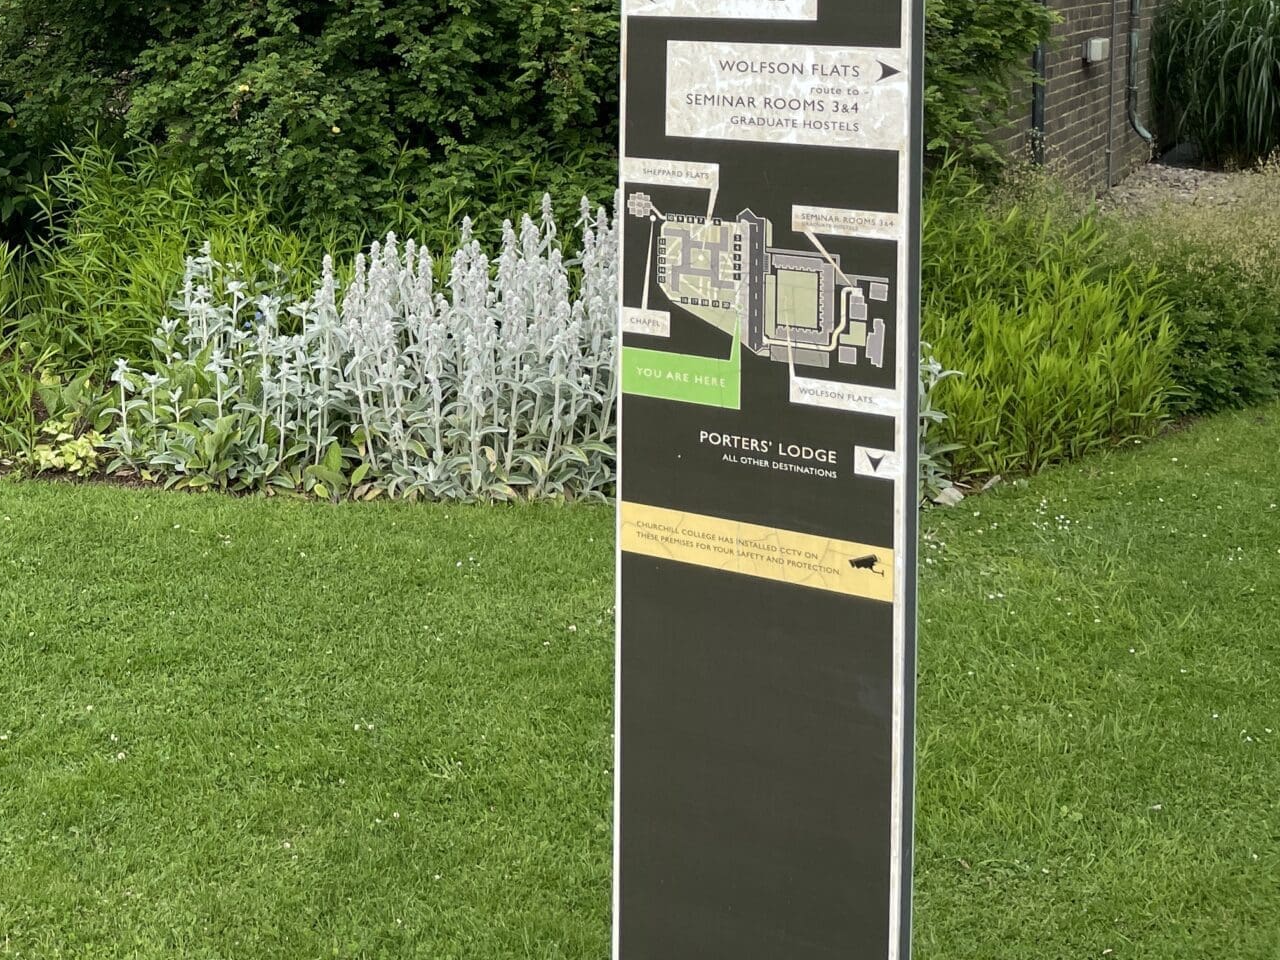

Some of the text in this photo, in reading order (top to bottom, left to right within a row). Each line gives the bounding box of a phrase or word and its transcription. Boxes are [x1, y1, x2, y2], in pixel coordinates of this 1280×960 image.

[719, 59, 860, 78] WOLFSON FLATS
[810, 86, 842, 95] route
[847, 87, 859, 96] to
[686, 93, 859, 114] SEMINAR ROOMS 3&4
[730, 115, 859, 132] GRADUATE HOSTELS
[642, 168, 710, 180] SHEPPARD FLATS
[801, 213, 841, 223] SEMINAR
[843, 216, 876, 226] ROOMS
[630, 317, 660, 328] CHAPEL
[636, 367, 726, 388] YOU ARE HERE
[798, 386, 873, 404] WOLFSON FLATS
[699, 430, 837, 464] PORTERS' LODGE
[722, 453, 838, 479] ALL OTHER DESTINATIONS
[636, 520, 818, 560] CHURCHILL COLLEGE HAS INSTALLED CCTV ON
[636, 531, 840, 576] THESE PREMISES FOR YOUR SAFETY AND PROTECTION
